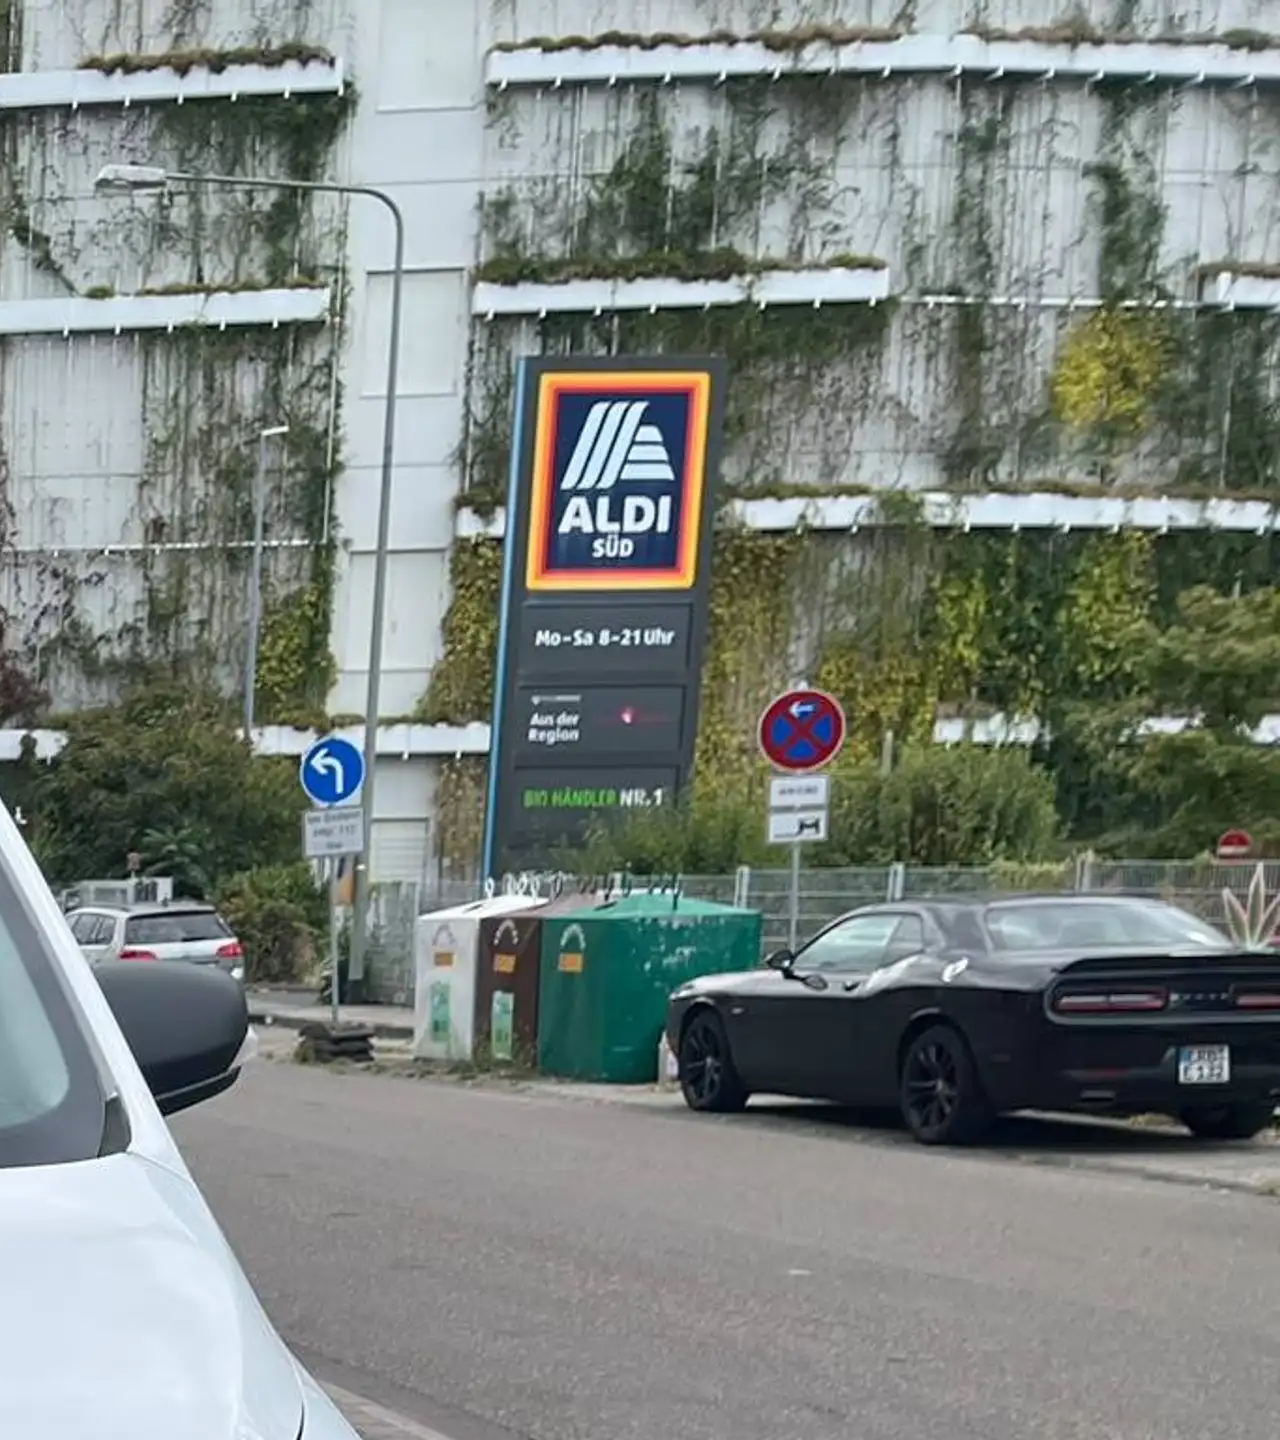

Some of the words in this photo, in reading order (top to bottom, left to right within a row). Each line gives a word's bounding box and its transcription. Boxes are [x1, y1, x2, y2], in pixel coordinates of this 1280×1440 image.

[558, 495, 672, 534] ALDI
[591, 533, 635, 559] SÜD
[643, 626, 676, 646] Uhr
[556, 710, 580, 726] der
[528, 727, 580, 746] Region
